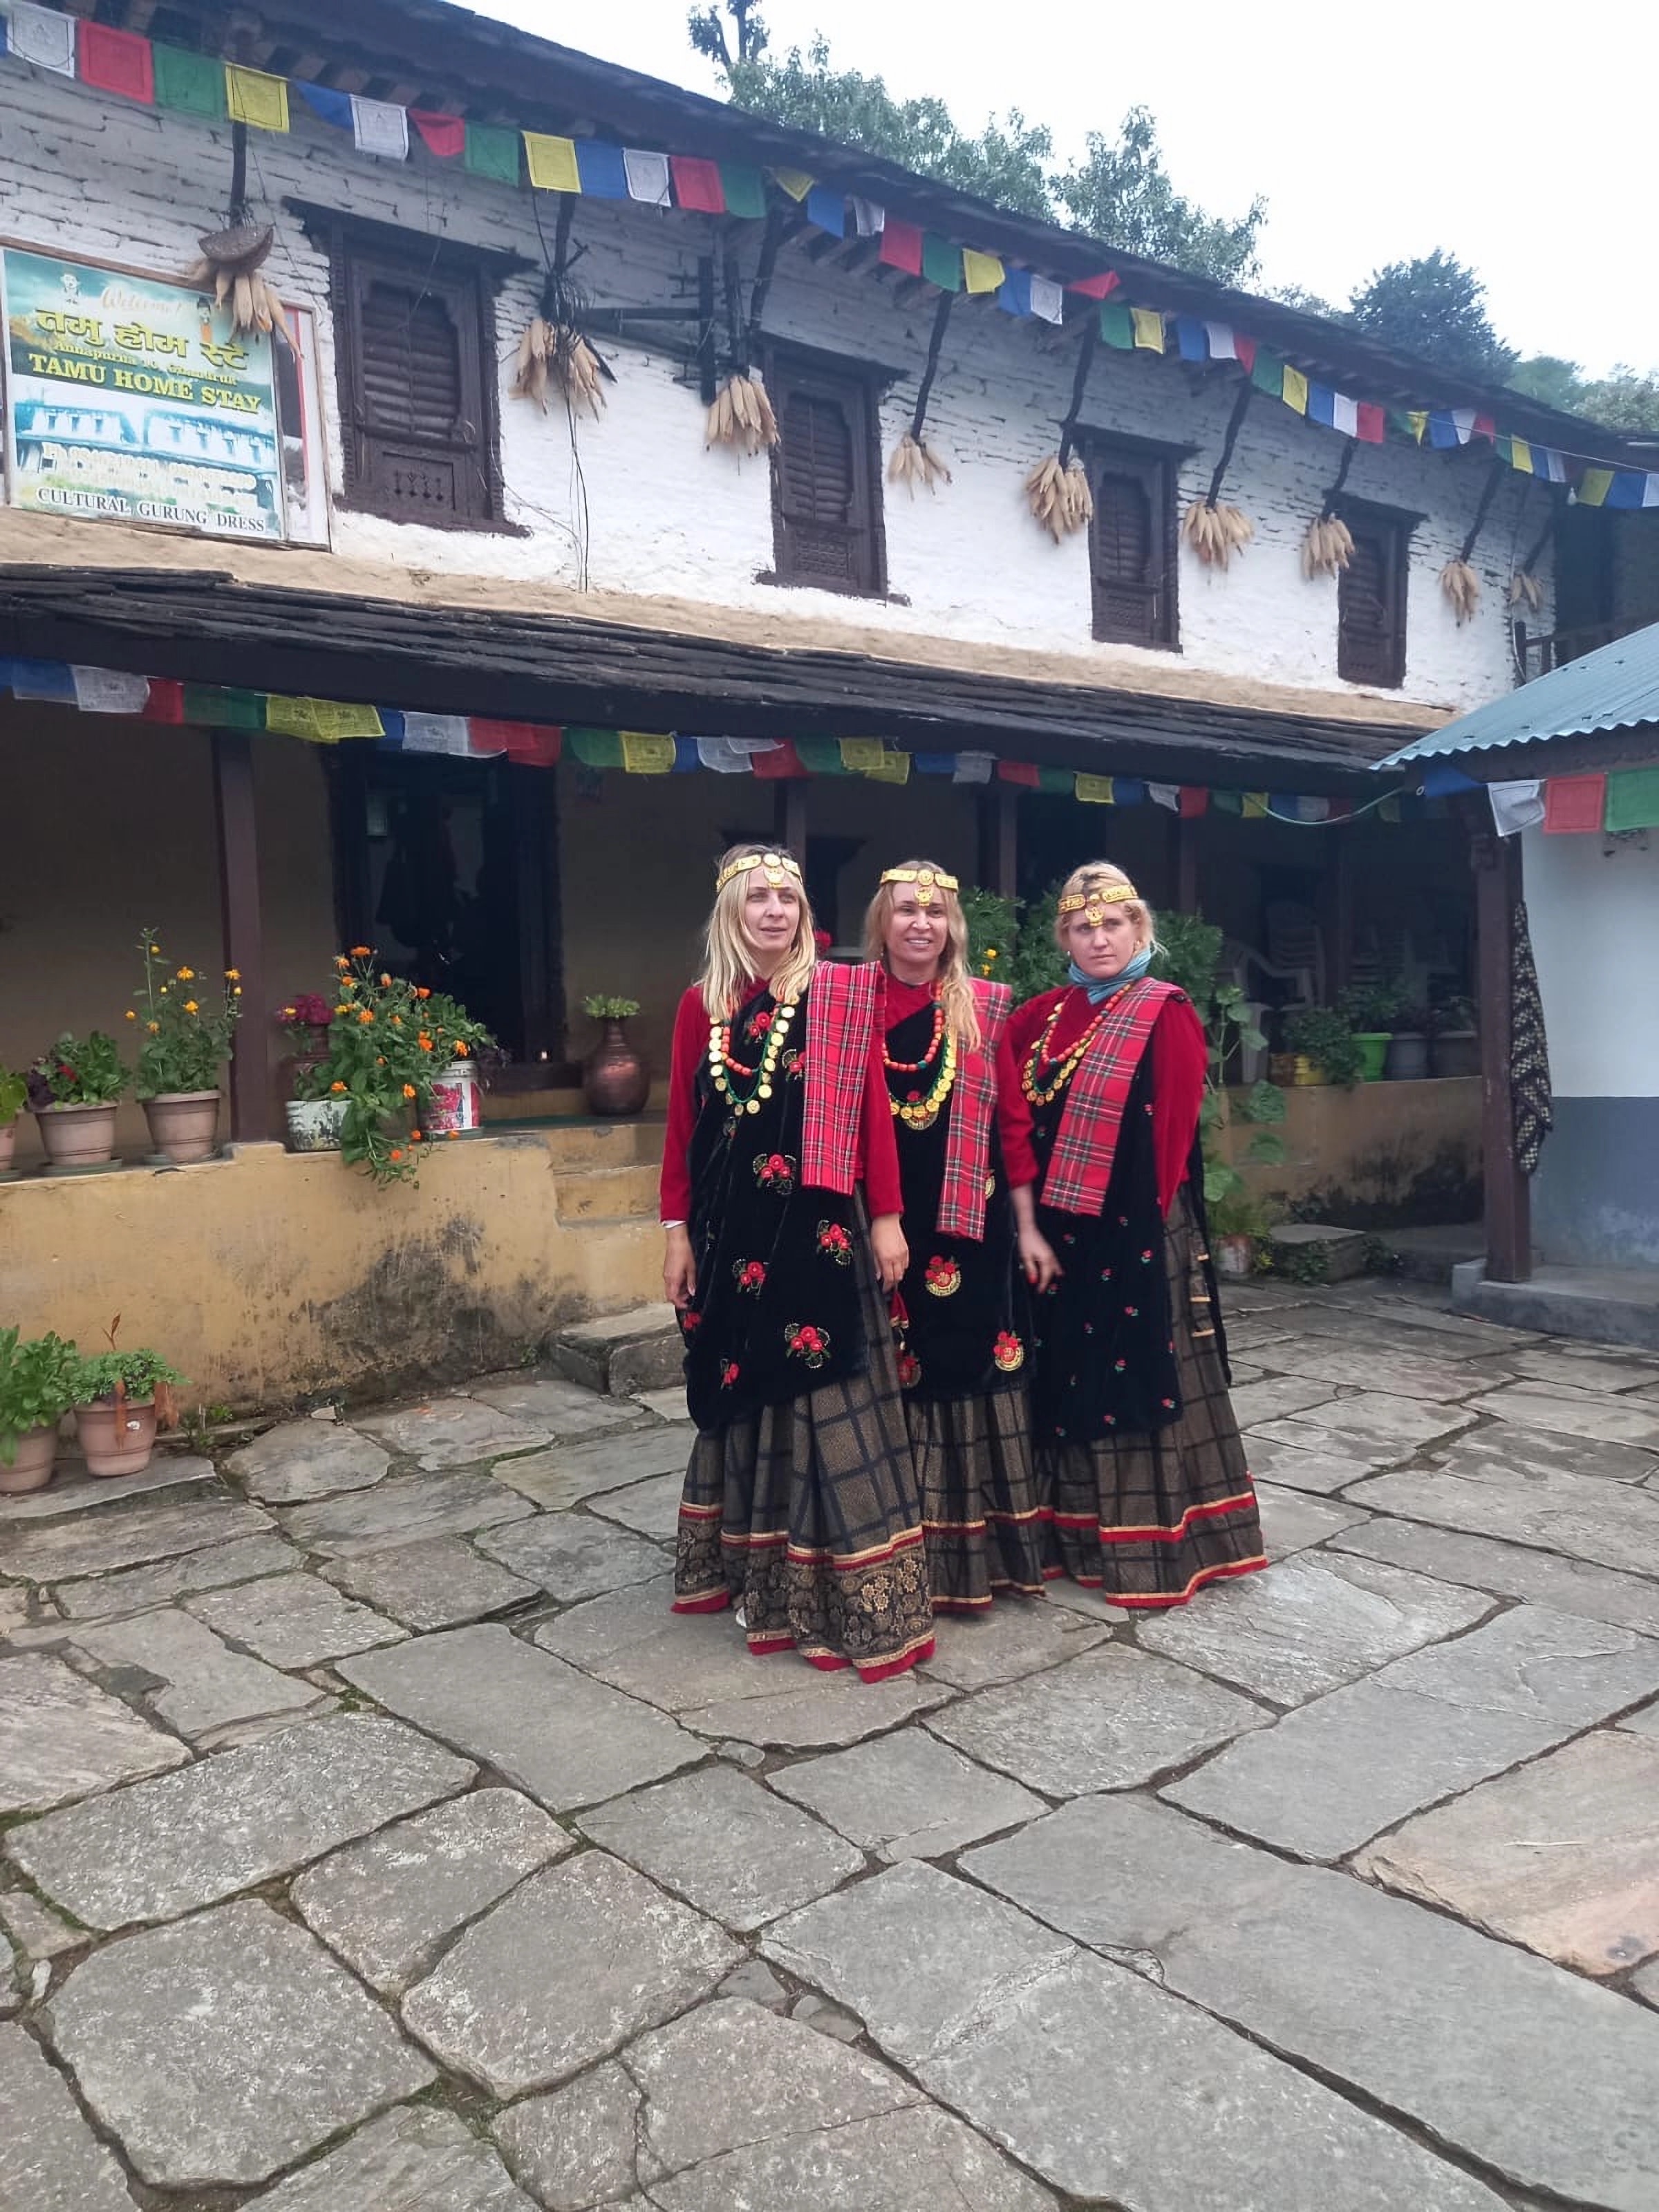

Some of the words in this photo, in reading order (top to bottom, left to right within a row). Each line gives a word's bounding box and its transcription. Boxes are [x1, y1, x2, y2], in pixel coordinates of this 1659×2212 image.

[35, 308, 105, 348] तमु
[113, 321, 189, 359] होम
[28, 353, 106, 384] TAMU
[113, 368, 194, 401] HOME
[200, 386, 262, 415] STAY
[37, 487, 132, 513] CULTURAL
[138, 502, 207, 524] GURUNG
[217, 512, 265, 532] DRESS
